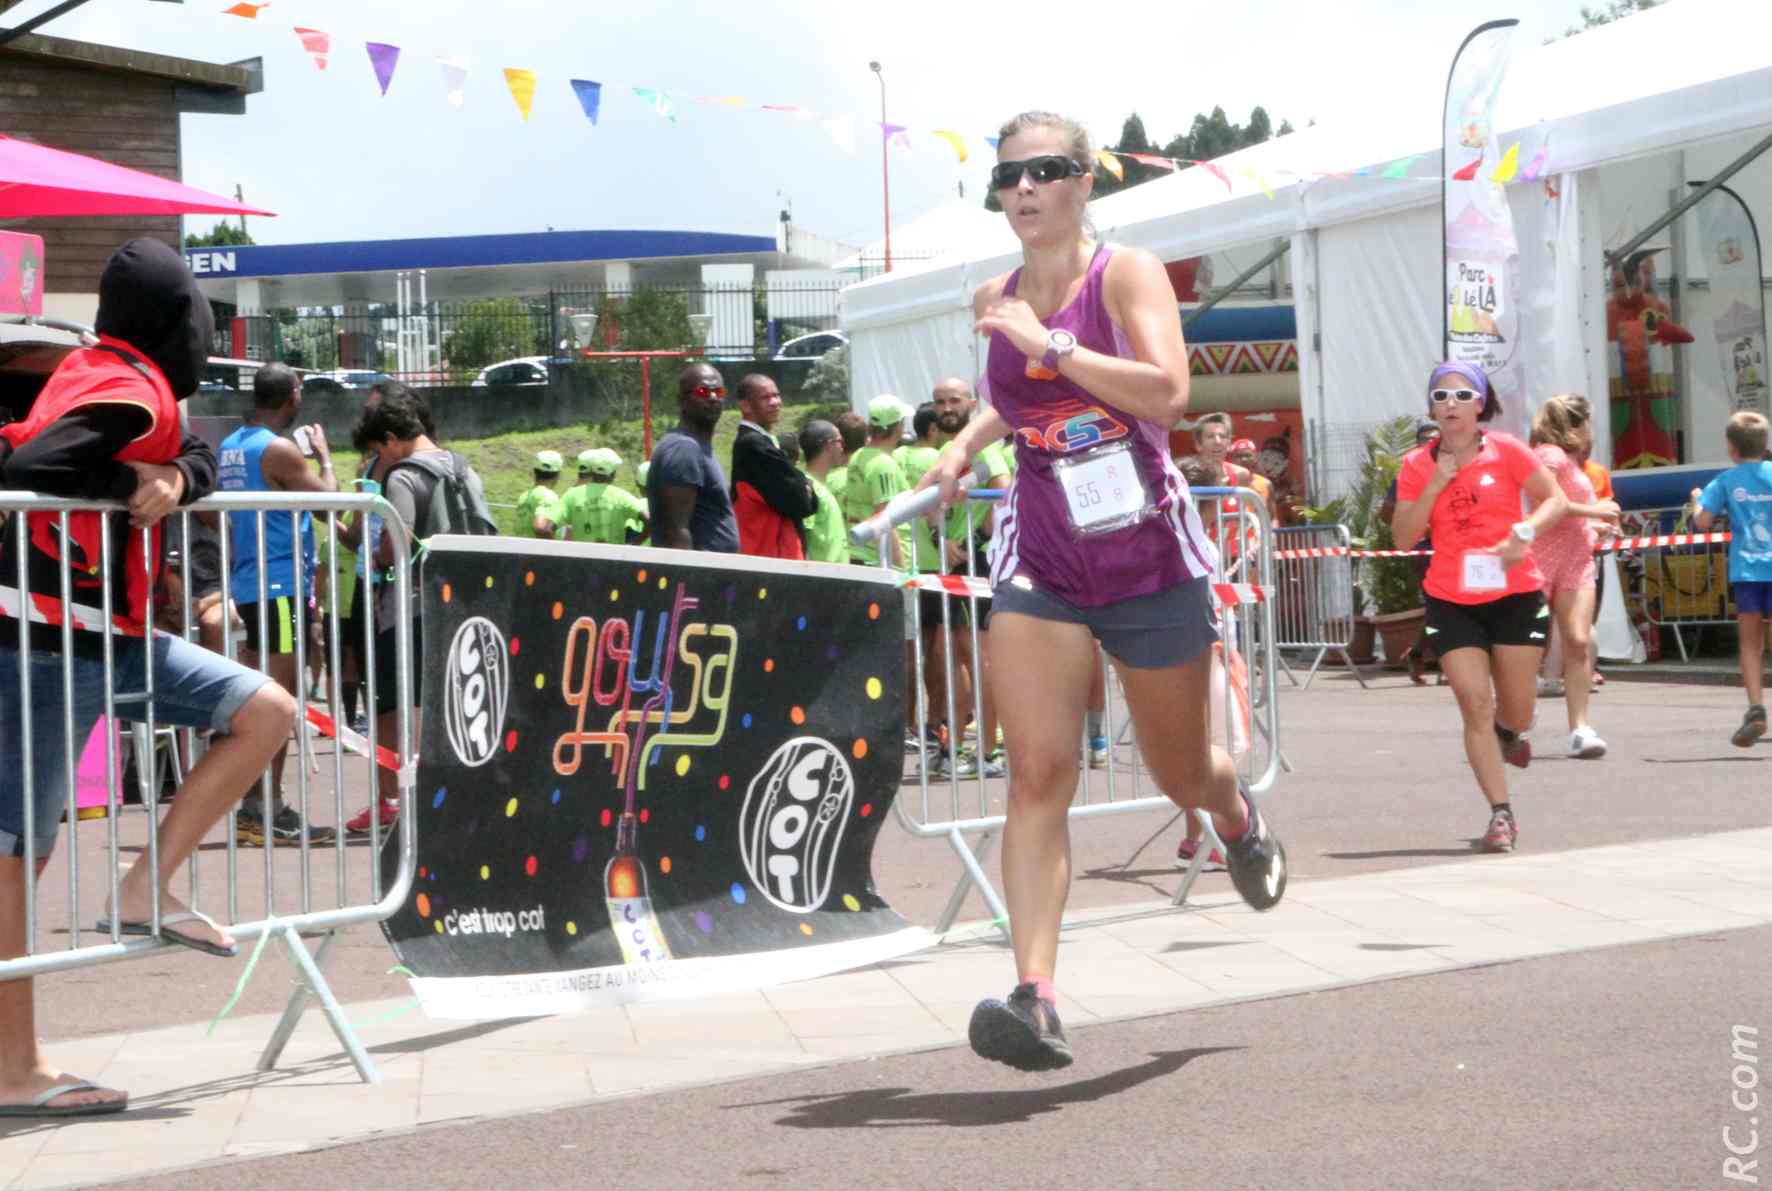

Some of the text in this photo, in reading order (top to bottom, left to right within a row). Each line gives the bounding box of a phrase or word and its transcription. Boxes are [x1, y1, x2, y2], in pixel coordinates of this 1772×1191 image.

[1458, 262, 1486, 283] Parc
[1075, 480, 1102, 509] 55
[460, 624, 488, 758] COT
[768, 749, 835, 905] COT
[481, 906, 516, 938] trop
